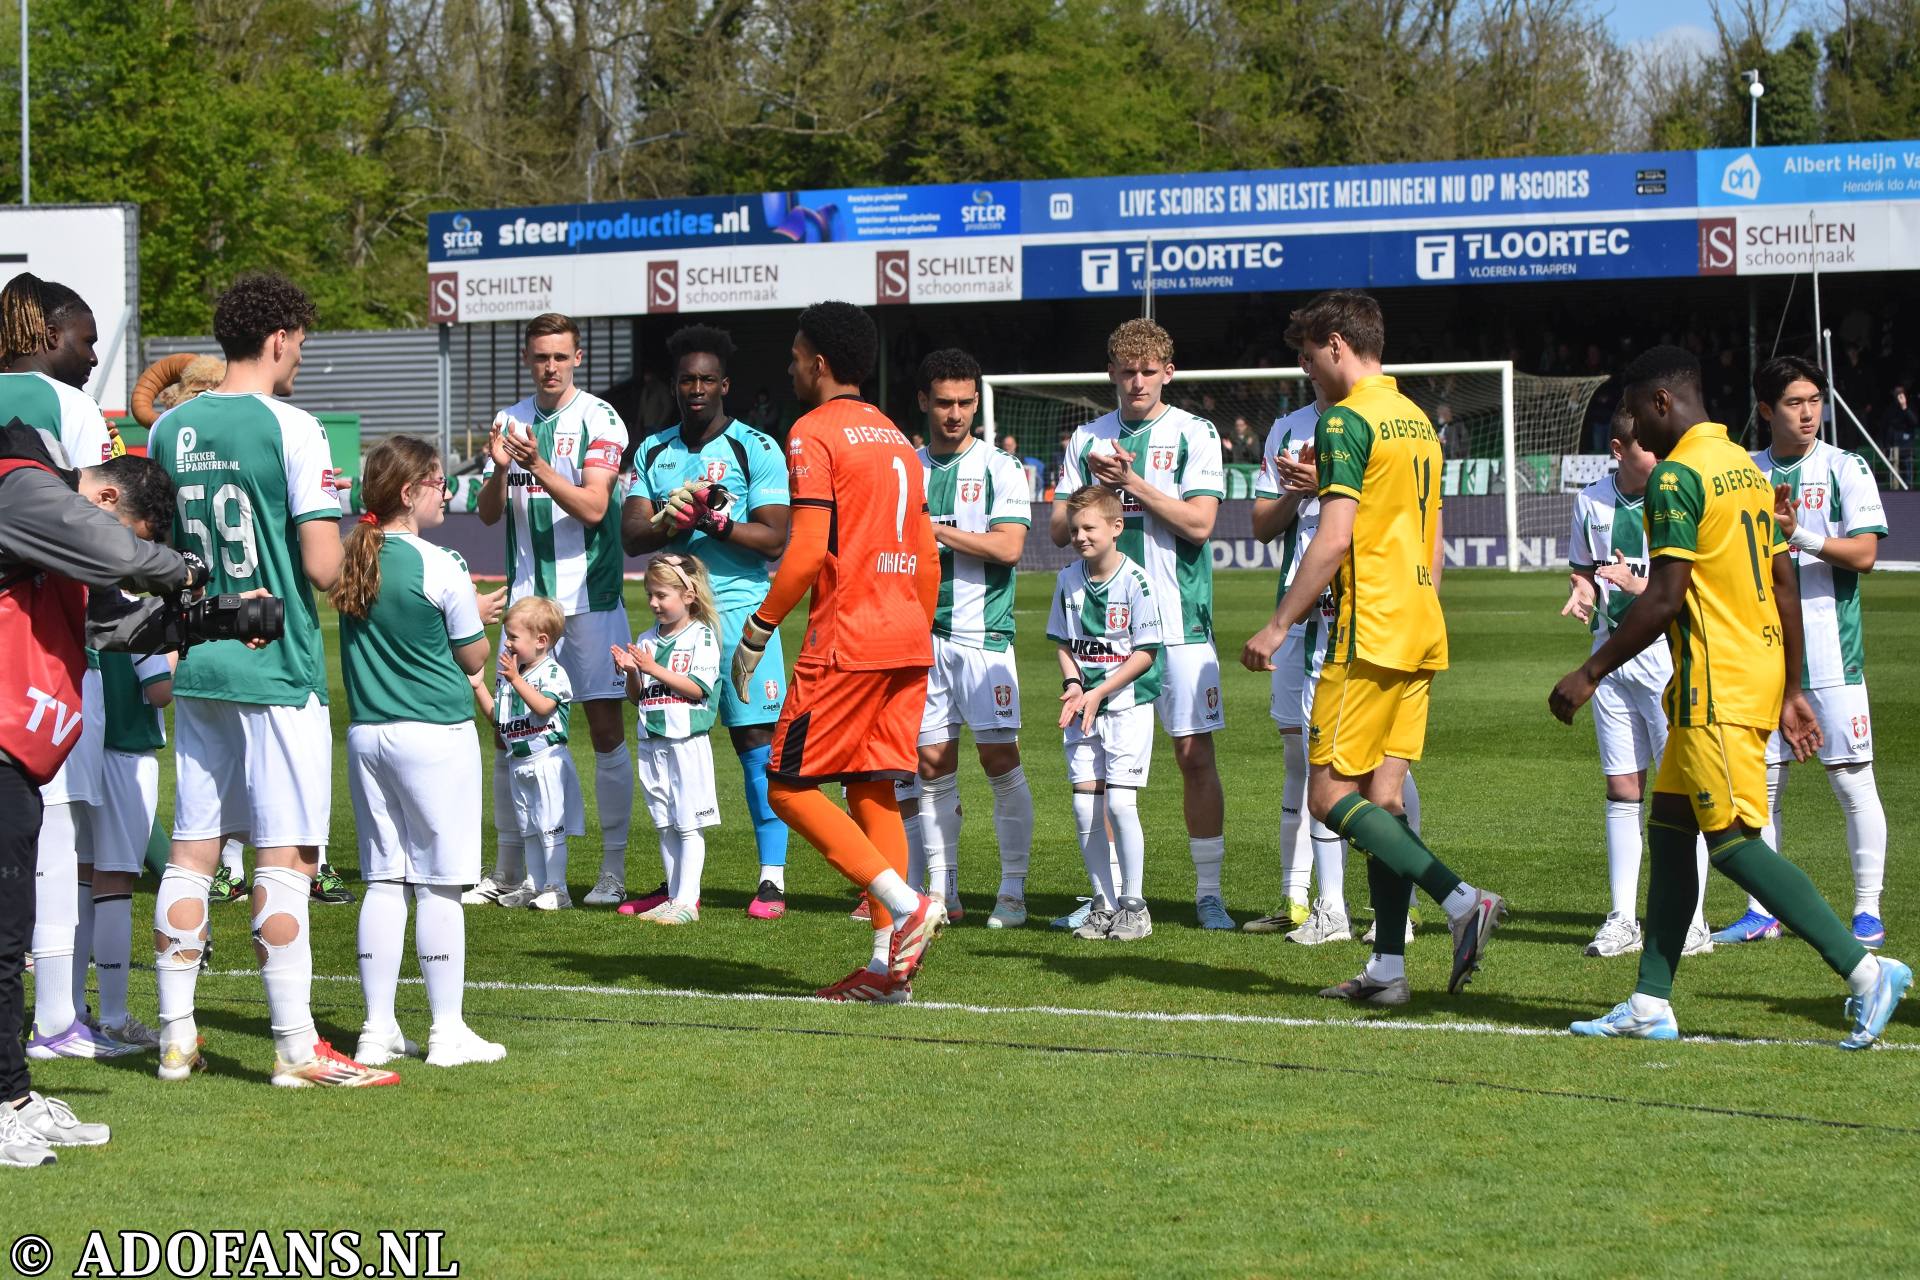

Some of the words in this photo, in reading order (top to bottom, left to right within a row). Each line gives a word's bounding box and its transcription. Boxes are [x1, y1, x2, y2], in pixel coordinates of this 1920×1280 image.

[1784, 154, 1841, 174] Albert
[1847, 152, 1896, 175] Heijn
[1120, 190, 1155, 217] LIVE
[1160, 187, 1225, 215] SCORES
[1230, 185, 1251, 213] EN
[1256, 181, 1330, 211] SNELSTE
[1334, 176, 1436, 208] MELDINGEN
[1442, 175, 1465, 203] NU
[1471, 174, 1494, 202] OP
[1843, 181, 1883, 195] Hendrik
[1887, 180, 1905, 192] Ido
[499, 206, 750, 247] sfeerproducties.nl
[1746, 223, 1855, 246] SCHILTEN
[1463, 228, 1630, 260] FLOORTEC
[918, 256, 1014, 276] SCHILTEN
[1126, 242, 1284, 272] FLOORTEC
[1746, 245, 1855, 266] schoonmaak
[686, 264, 778, 285] SCHILTEN
[1469, 265, 1517, 278] VLOEREN
[1519, 266, 1528, 275] &
[1530, 263, 1577, 276] TRAPPEN
[466, 275, 552, 296] SCHILTEN
[917, 276, 1013, 295] schoonmaak
[1179, 277, 1187, 288] &
[1189, 276, 1233, 288] TRAPPEN
[686, 285, 778, 305] schoonmaak
[465, 297, 551, 315] schoonmaak
[185, 451, 215, 462] LEKKER
[176, 484, 258, 579] 59
[26, 686, 82, 747] TV
